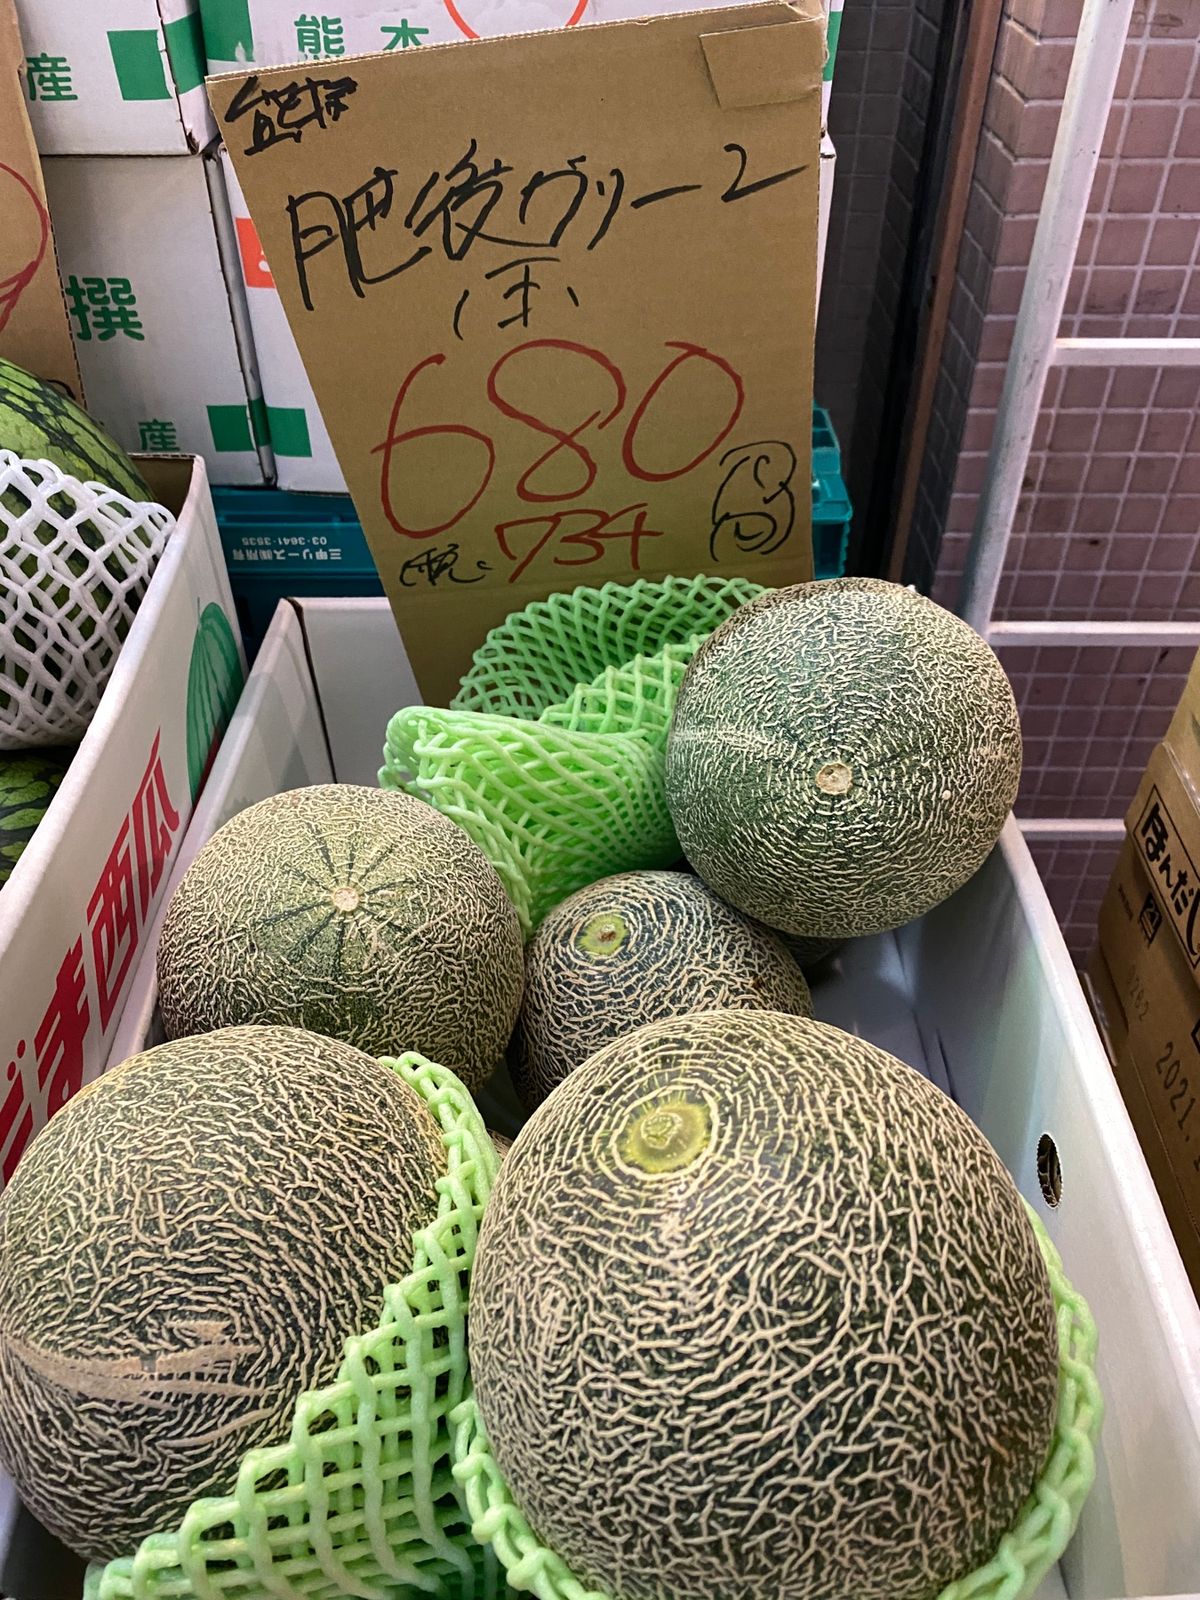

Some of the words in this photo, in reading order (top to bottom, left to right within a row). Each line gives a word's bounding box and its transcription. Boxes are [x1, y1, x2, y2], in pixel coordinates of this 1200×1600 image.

[27, 53, 78, 102] 産
[65, 275, 145, 341] 撰
[138, 419, 180, 452] 産
[371, 339, 745, 539] 680
[494, 503, 665, 583] 734
